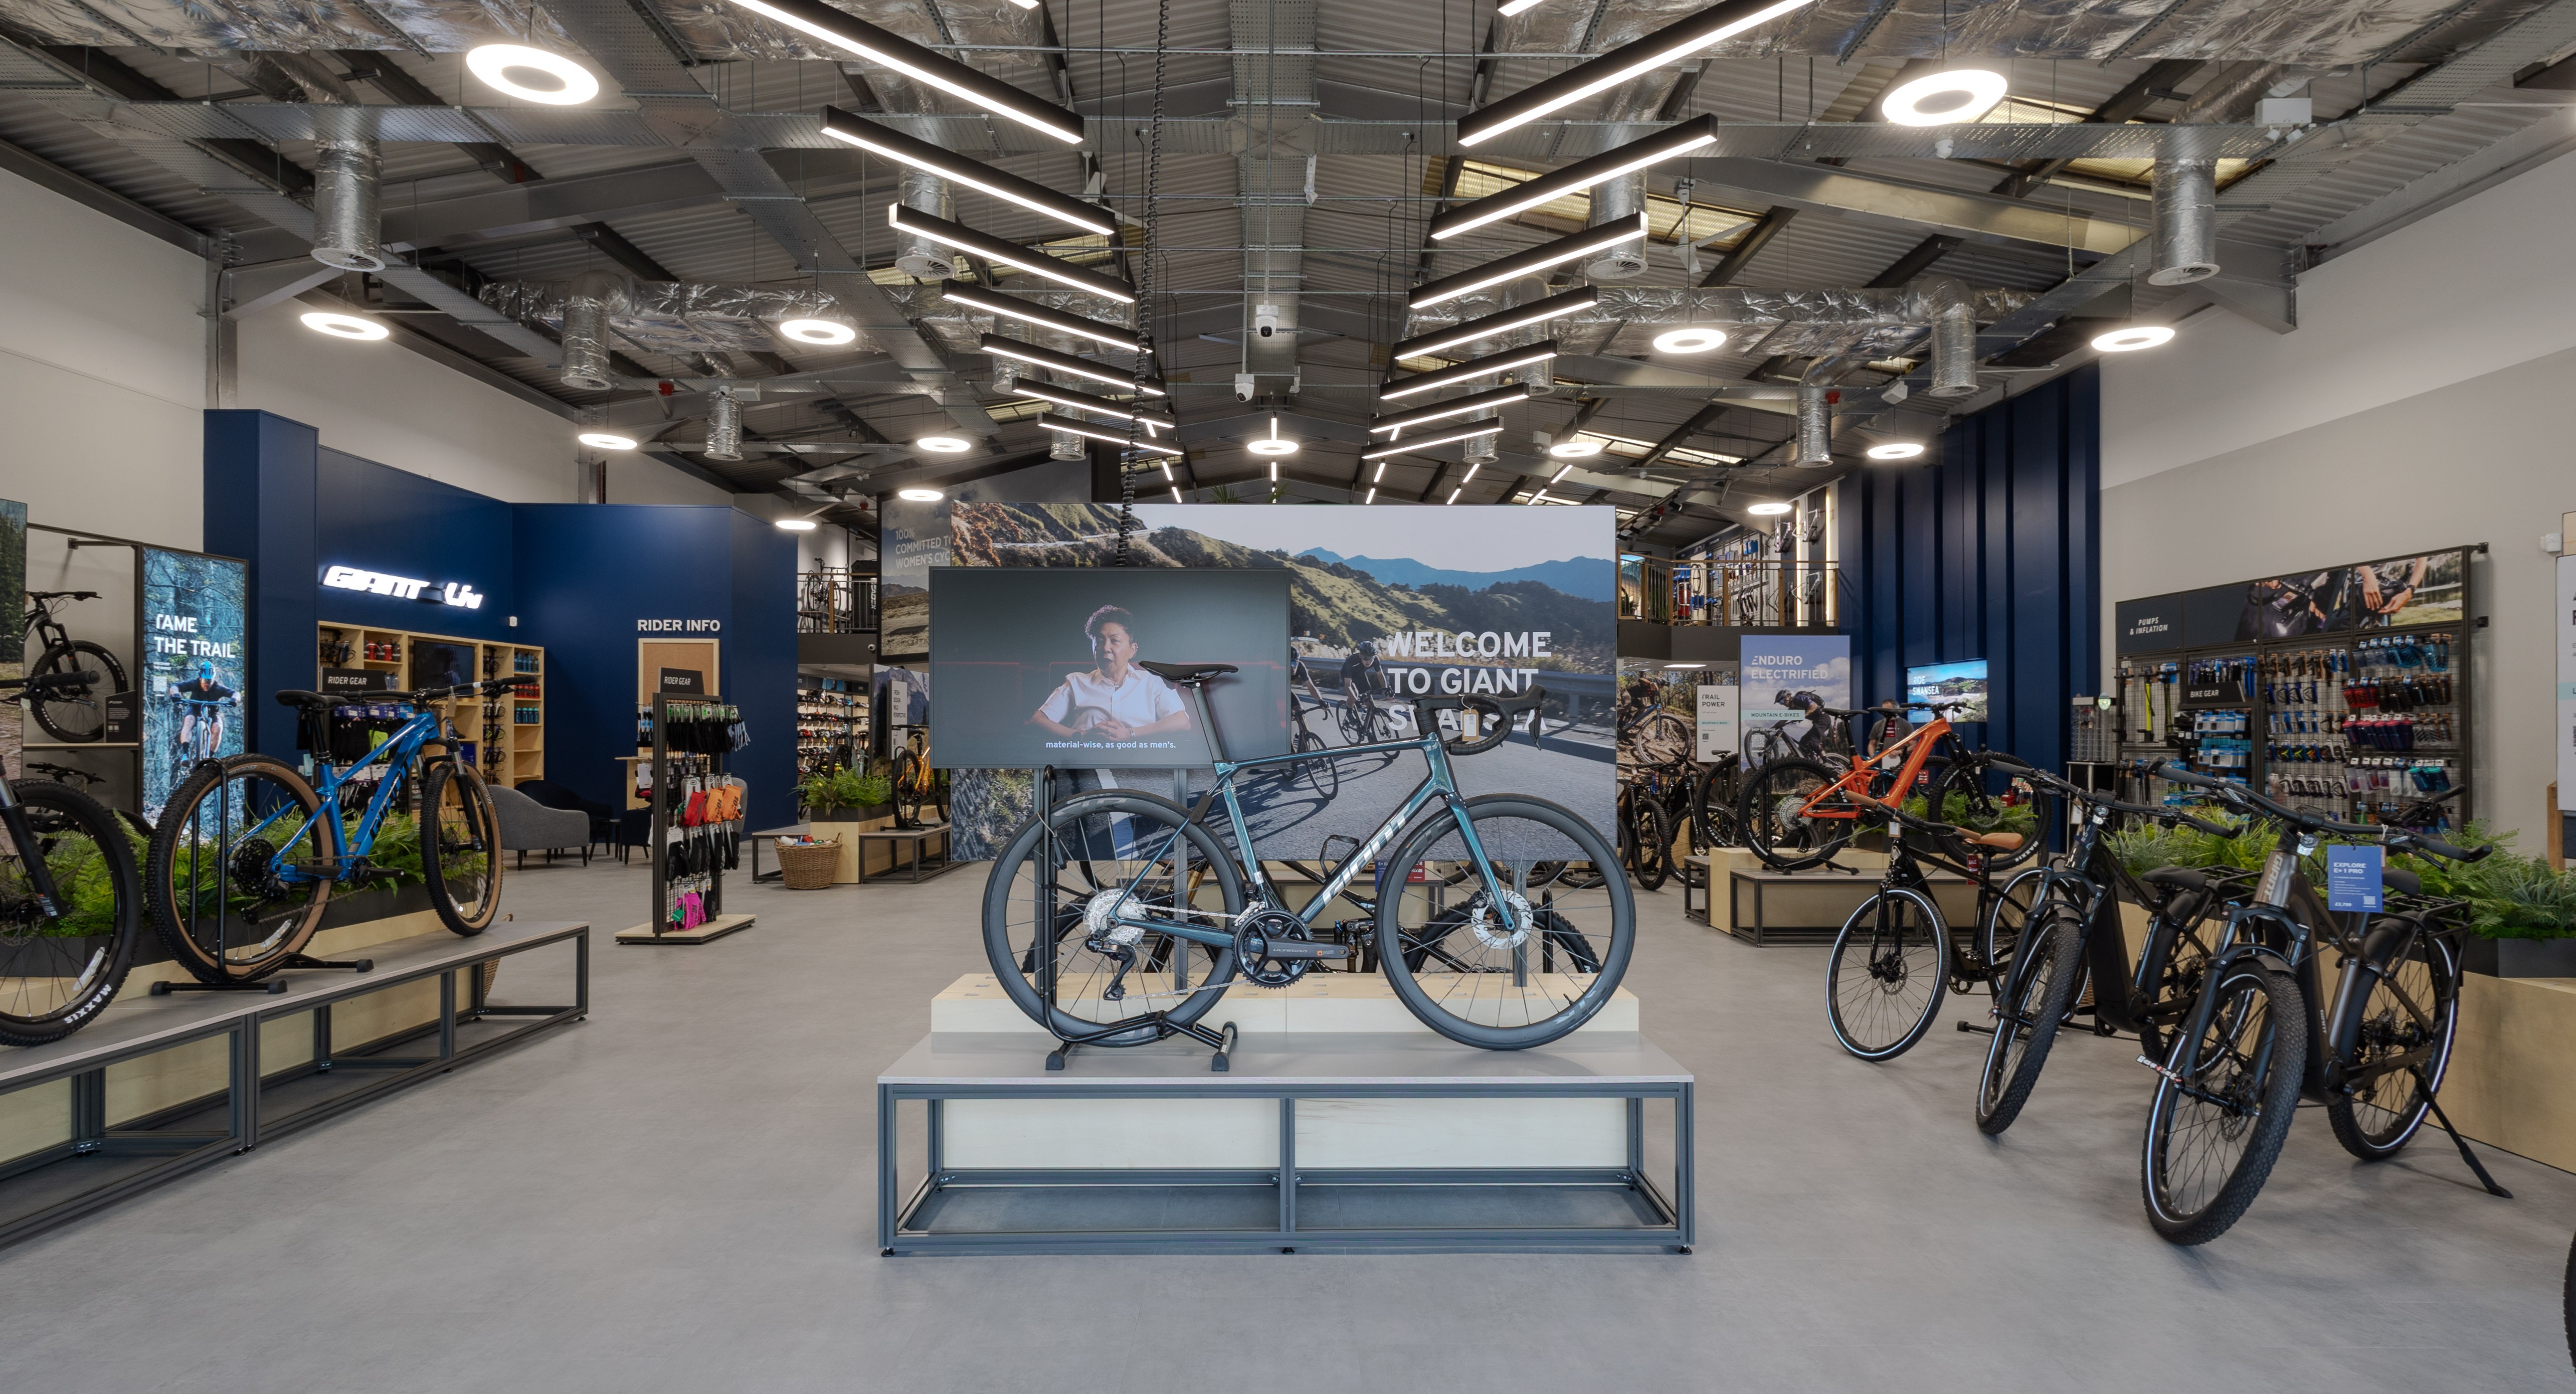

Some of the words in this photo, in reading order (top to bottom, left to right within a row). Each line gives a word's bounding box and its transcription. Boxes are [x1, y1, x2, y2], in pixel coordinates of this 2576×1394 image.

[896, 527, 915, 540] 100%
[896, 537, 941, 554] COMMITTED
[896, 553, 933, 568] WOMEN'S
[324, 566, 431, 599] GIANT
[156, 613, 198, 633] TAME
[637, 619, 683, 631] RIDER
[687, 619, 721, 632] INFO
[2136, 624, 2168, 634] INFLATION
[2138, 617, 2159, 626] PUMPS
[154, 636, 187, 655] THE
[190, 640, 236, 658] TRAIL
[1388, 631, 1552, 657] WELCOME
[1751, 656, 1803, 665] ENDURO
[664, 676, 678, 685] RIDER
[1387, 668, 1431, 694] TO
[1441, 668, 1539, 694] GIANT
[1751, 670, 1828, 679] ELECTRIFIED
[1912, 686, 1940, 696] SWANSEA
[1116, 741, 1136, 749] good
[1322, 802, 1411, 906] GIANT
[2015, 841, 2039, 862] MAXXIS
[2264, 854, 2283, 901] GIANT
[64, 984, 112, 1024] MAXXIS
